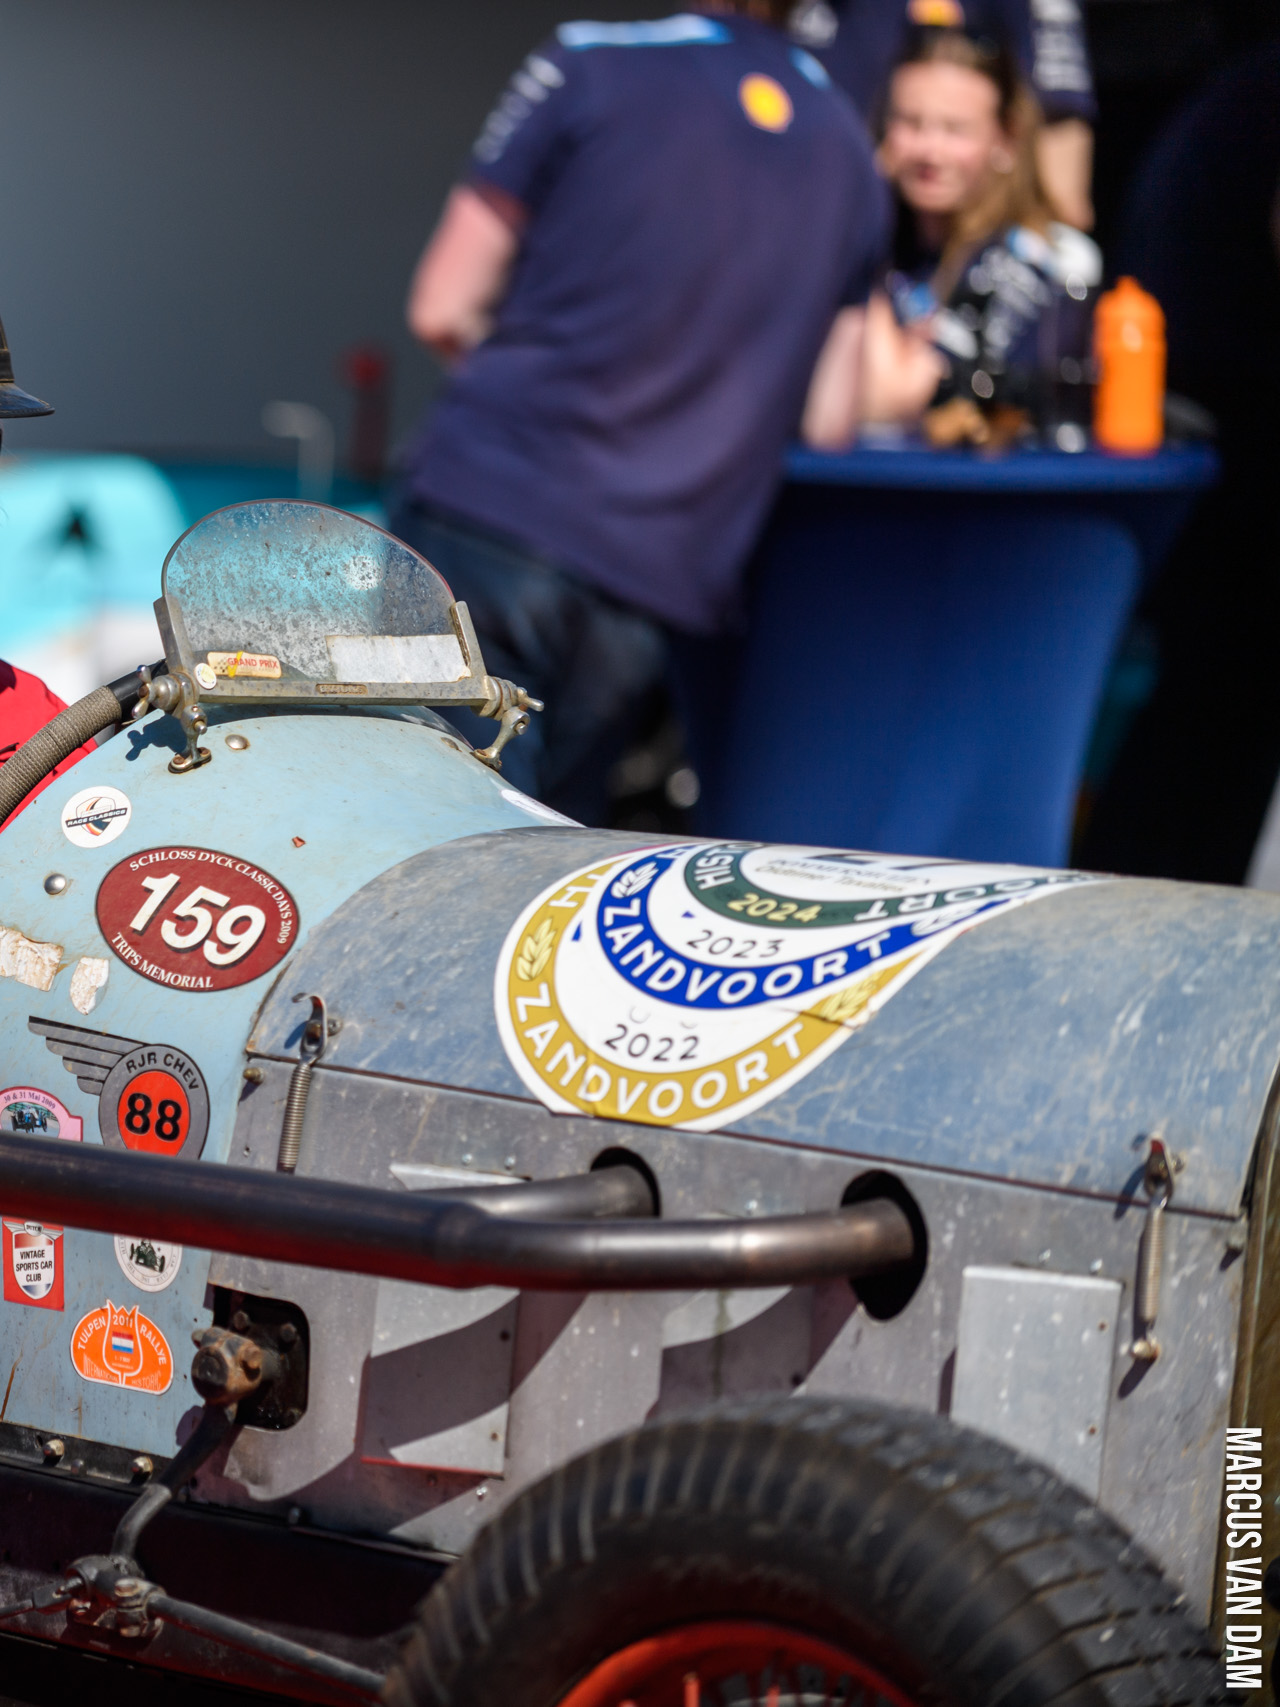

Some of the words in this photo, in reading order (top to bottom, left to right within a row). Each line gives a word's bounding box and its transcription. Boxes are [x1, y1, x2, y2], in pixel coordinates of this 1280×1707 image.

[227, 657, 257, 667] GRAND
[259, 658, 279, 669] PRIX
[67, 817, 88, 826] RACE
[89, 808, 126, 822] CLASSICS
[129, 850, 197, 871] SCHLOSS
[198, 852, 236, 868] DYCK
[235, 863, 279, 894] CLASSIC
[129, 872, 266, 966] 159
[272, 891, 292, 919] DAYS
[726, 892, 822, 923] 2024
[277, 919, 292, 944] 2009
[686, 929, 785, 959] 2023
[111, 931, 142, 966] TRIPS
[138, 959, 214, 989] MEMORIAL
[603, 897, 892, 1004] ZANDVOORT
[515, 981, 804, 1118] ZANDVOORT
[604, 1022, 700, 1062] 2022
[125, 1051, 158, 1074] RJR
[163, 1053, 199, 1091] CHEV
[124, 1092, 183, 1142] 88
[16, 1262, 39, 1272] SPORTS
[40, 1260, 53, 1270] CAR
[20, 1250, 45, 1260] VINTAGE
[26, 1273, 41, 1282] CLUB
[78, 1315, 107, 1350] TULPEN
[113, 1314, 134, 1329] 2011
[139, 1324, 167, 1365] RALLYE
